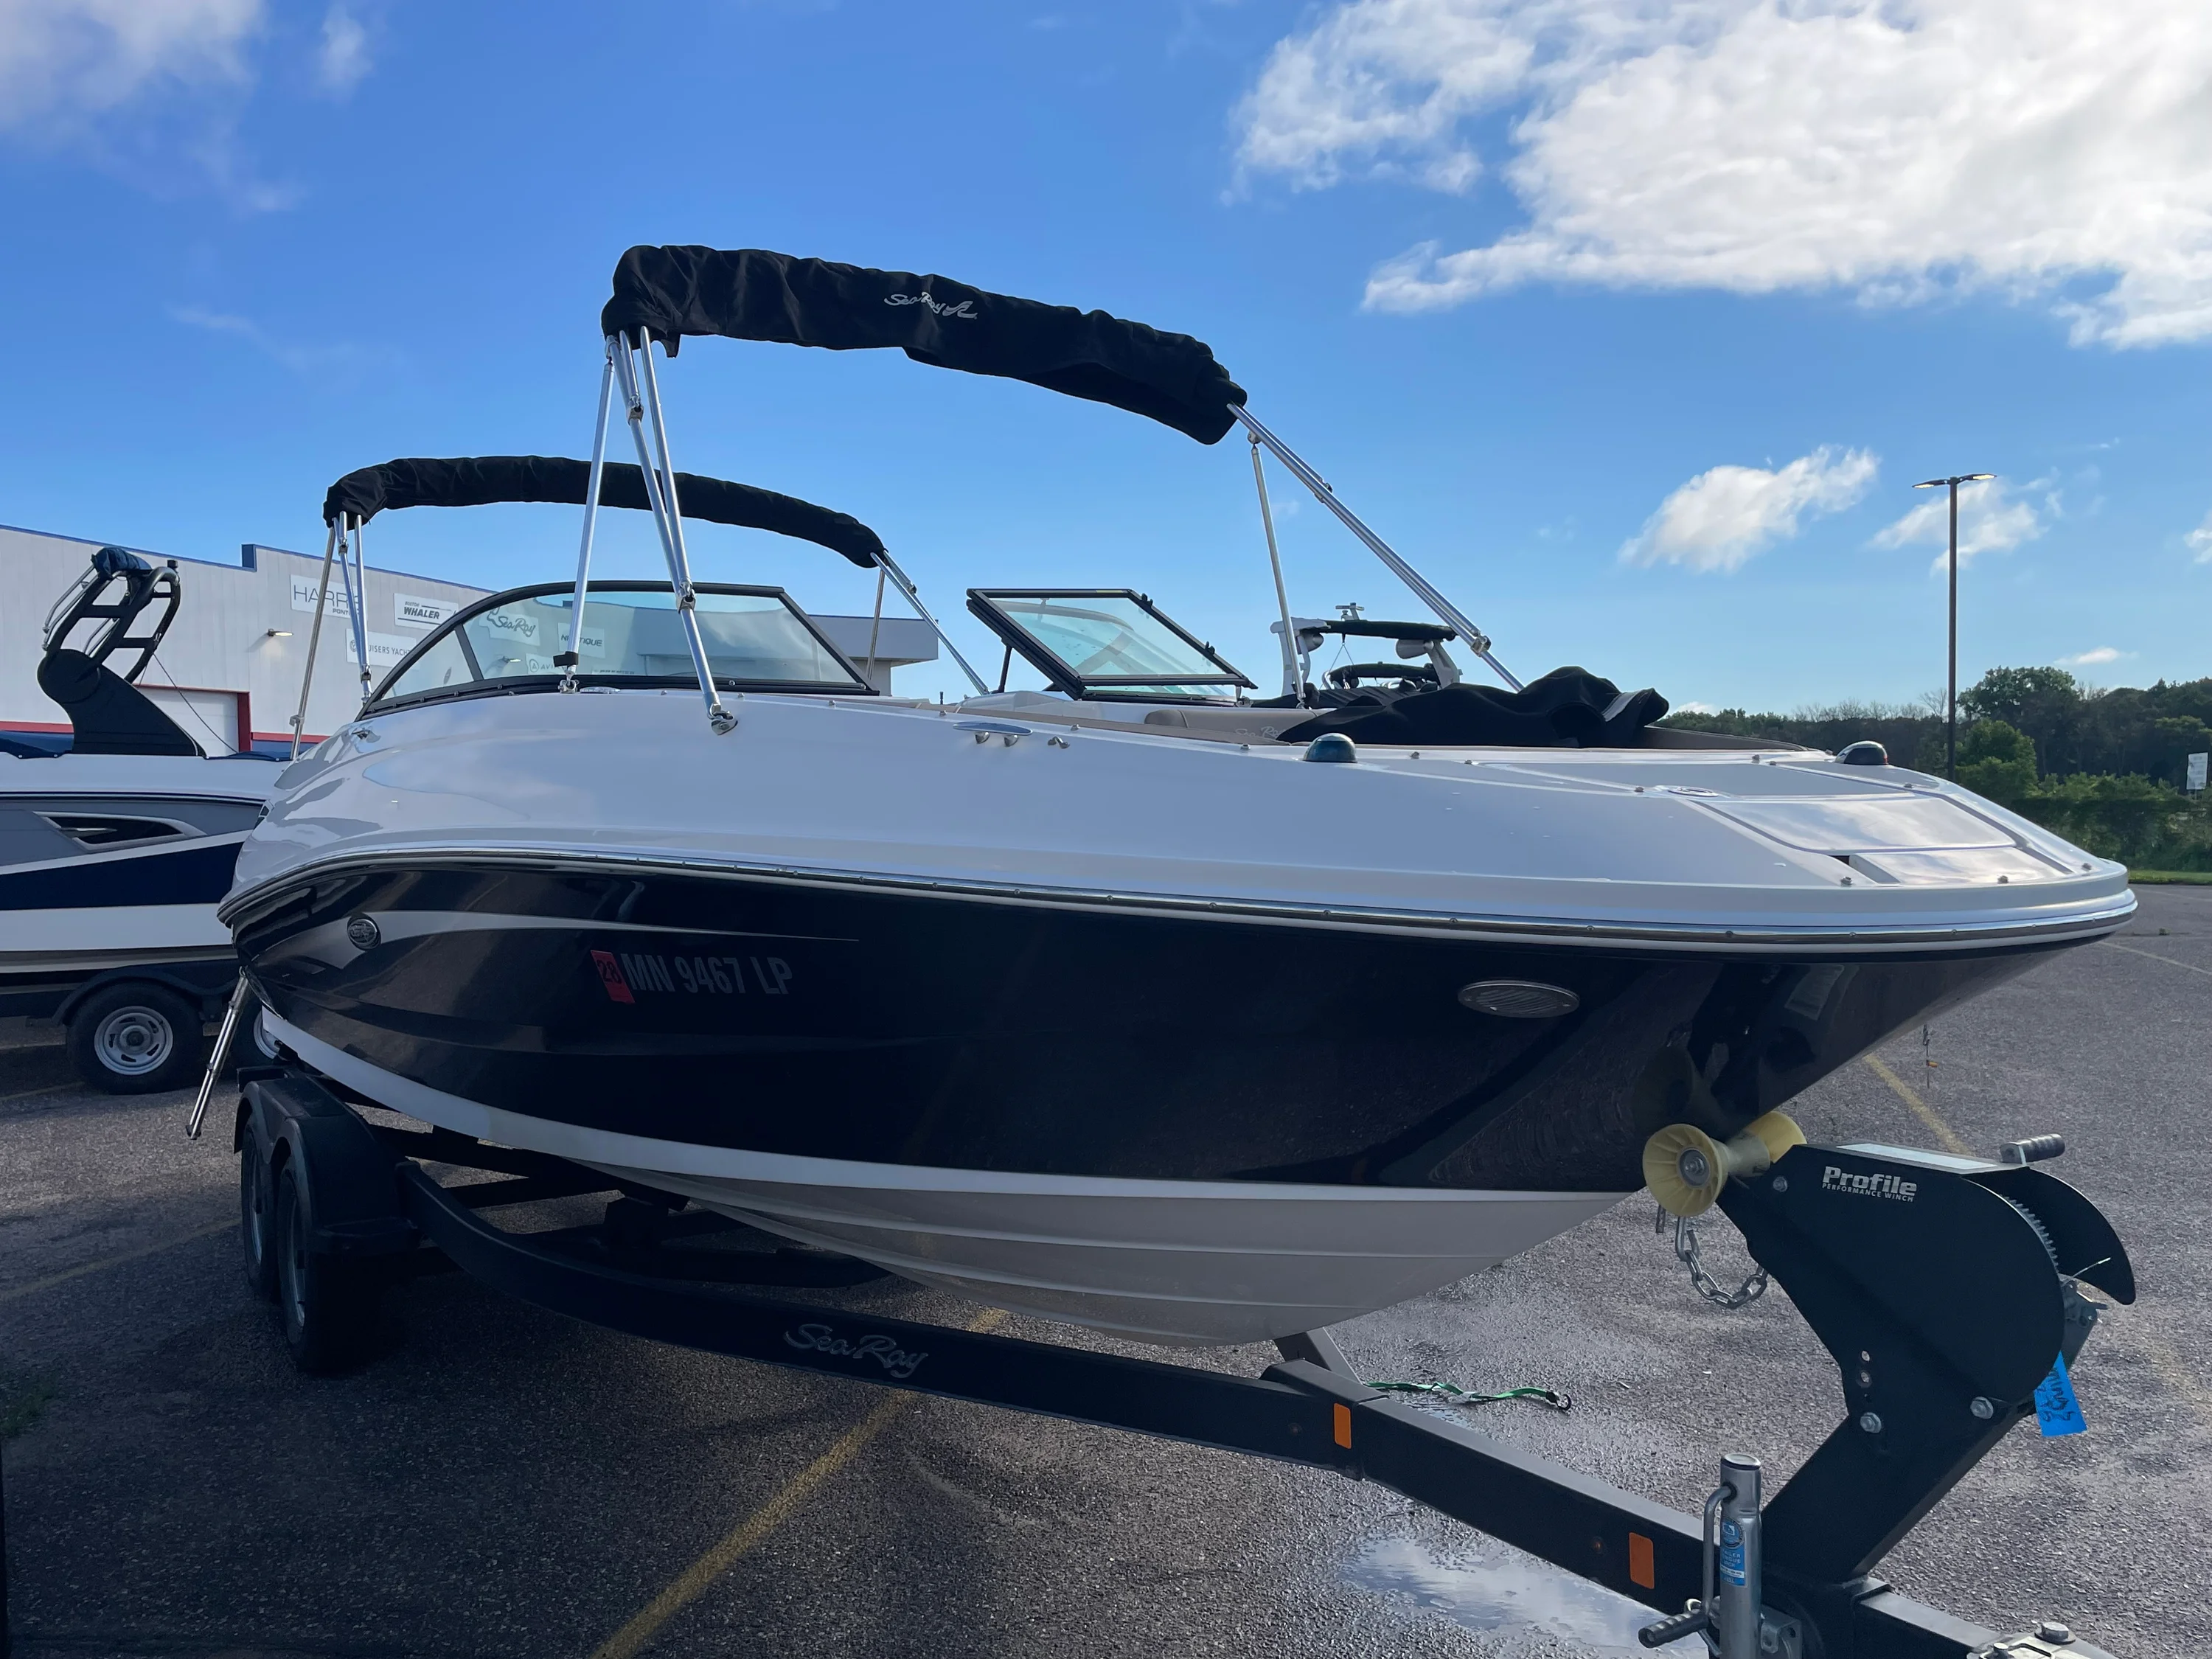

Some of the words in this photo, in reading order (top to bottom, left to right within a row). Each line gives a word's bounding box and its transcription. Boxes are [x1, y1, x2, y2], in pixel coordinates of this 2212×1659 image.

[403, 606, 440, 619] WHALER
[620, 953, 675, 992] MN
[674, 956, 746, 994] 9467
[749, 956, 793, 994] LP
[1822, 1183, 1882, 1197] PERFORMANCE
[1885, 1192, 1914, 1202] WINCH
[1823, 1166, 1917, 1197] Profile
[783, 1324, 856, 1356] Sea
[852, 1335, 929, 1379] Ray
